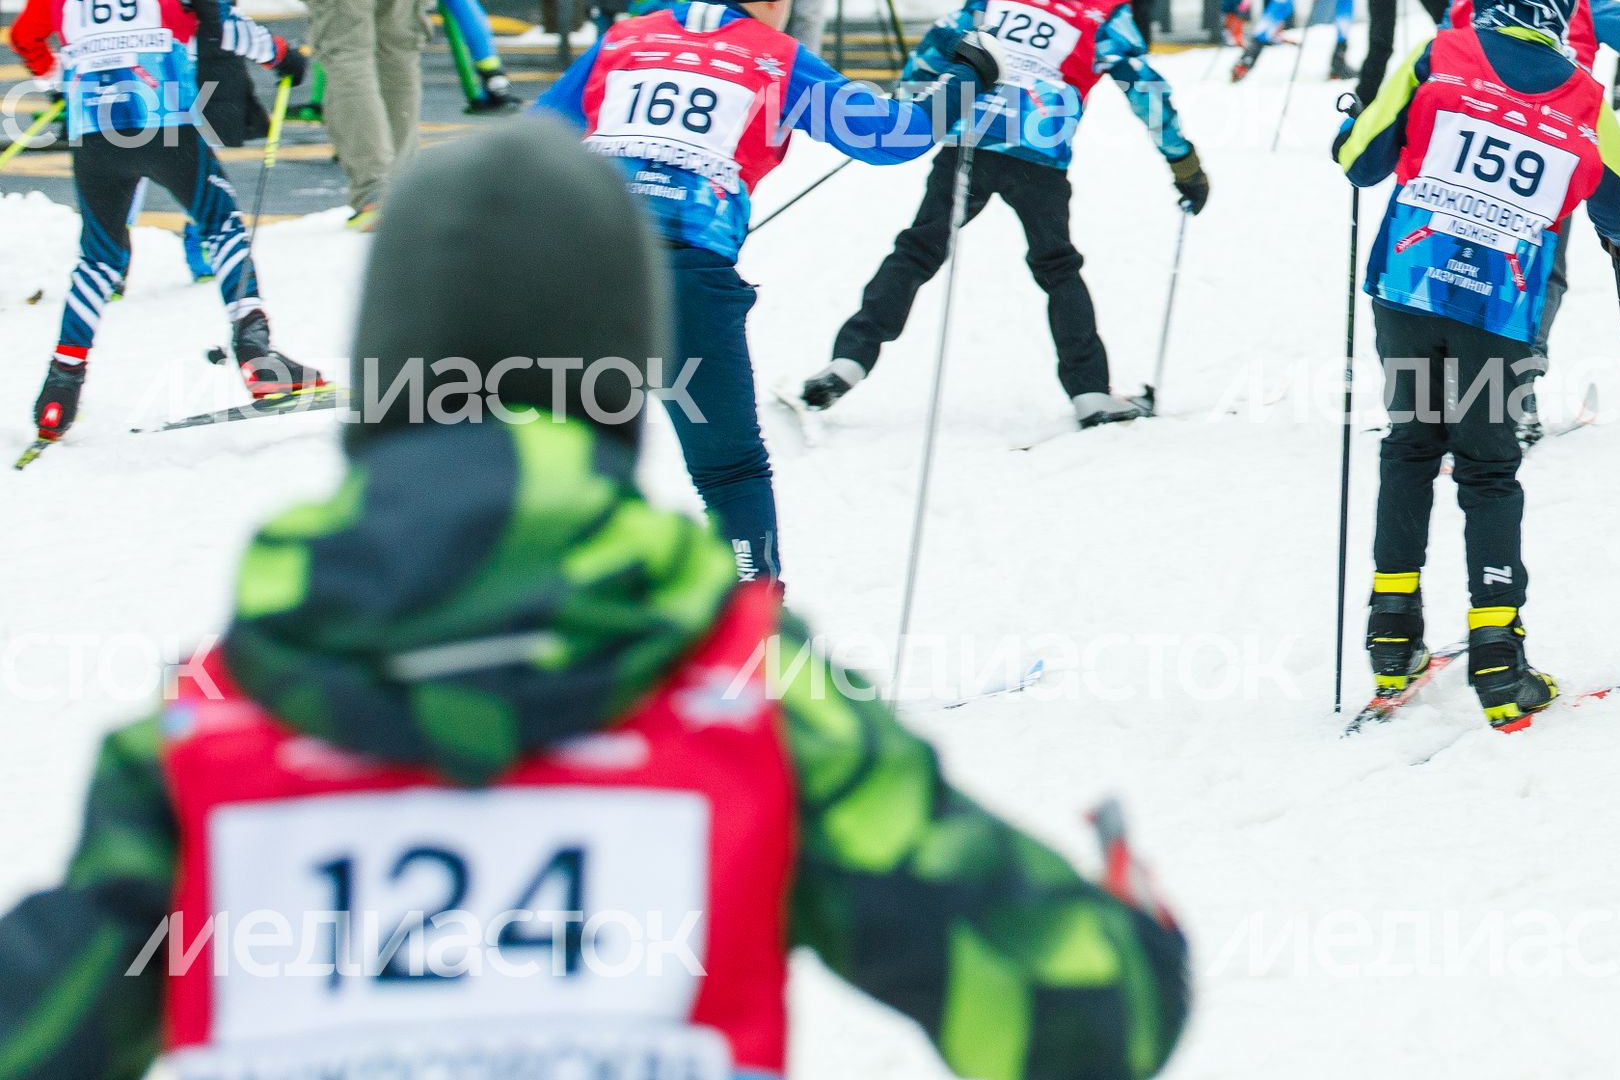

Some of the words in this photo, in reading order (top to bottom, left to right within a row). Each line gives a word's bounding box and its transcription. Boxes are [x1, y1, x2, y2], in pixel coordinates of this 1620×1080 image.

[996, 10, 1056, 49] 128
[624, 81, 717, 134] 168
[1454, 130, 1545, 198] 159
[1446, 258, 1480, 279] ПАРК
[731, 538, 760, 582] swix
[312, 844, 600, 993] 124
